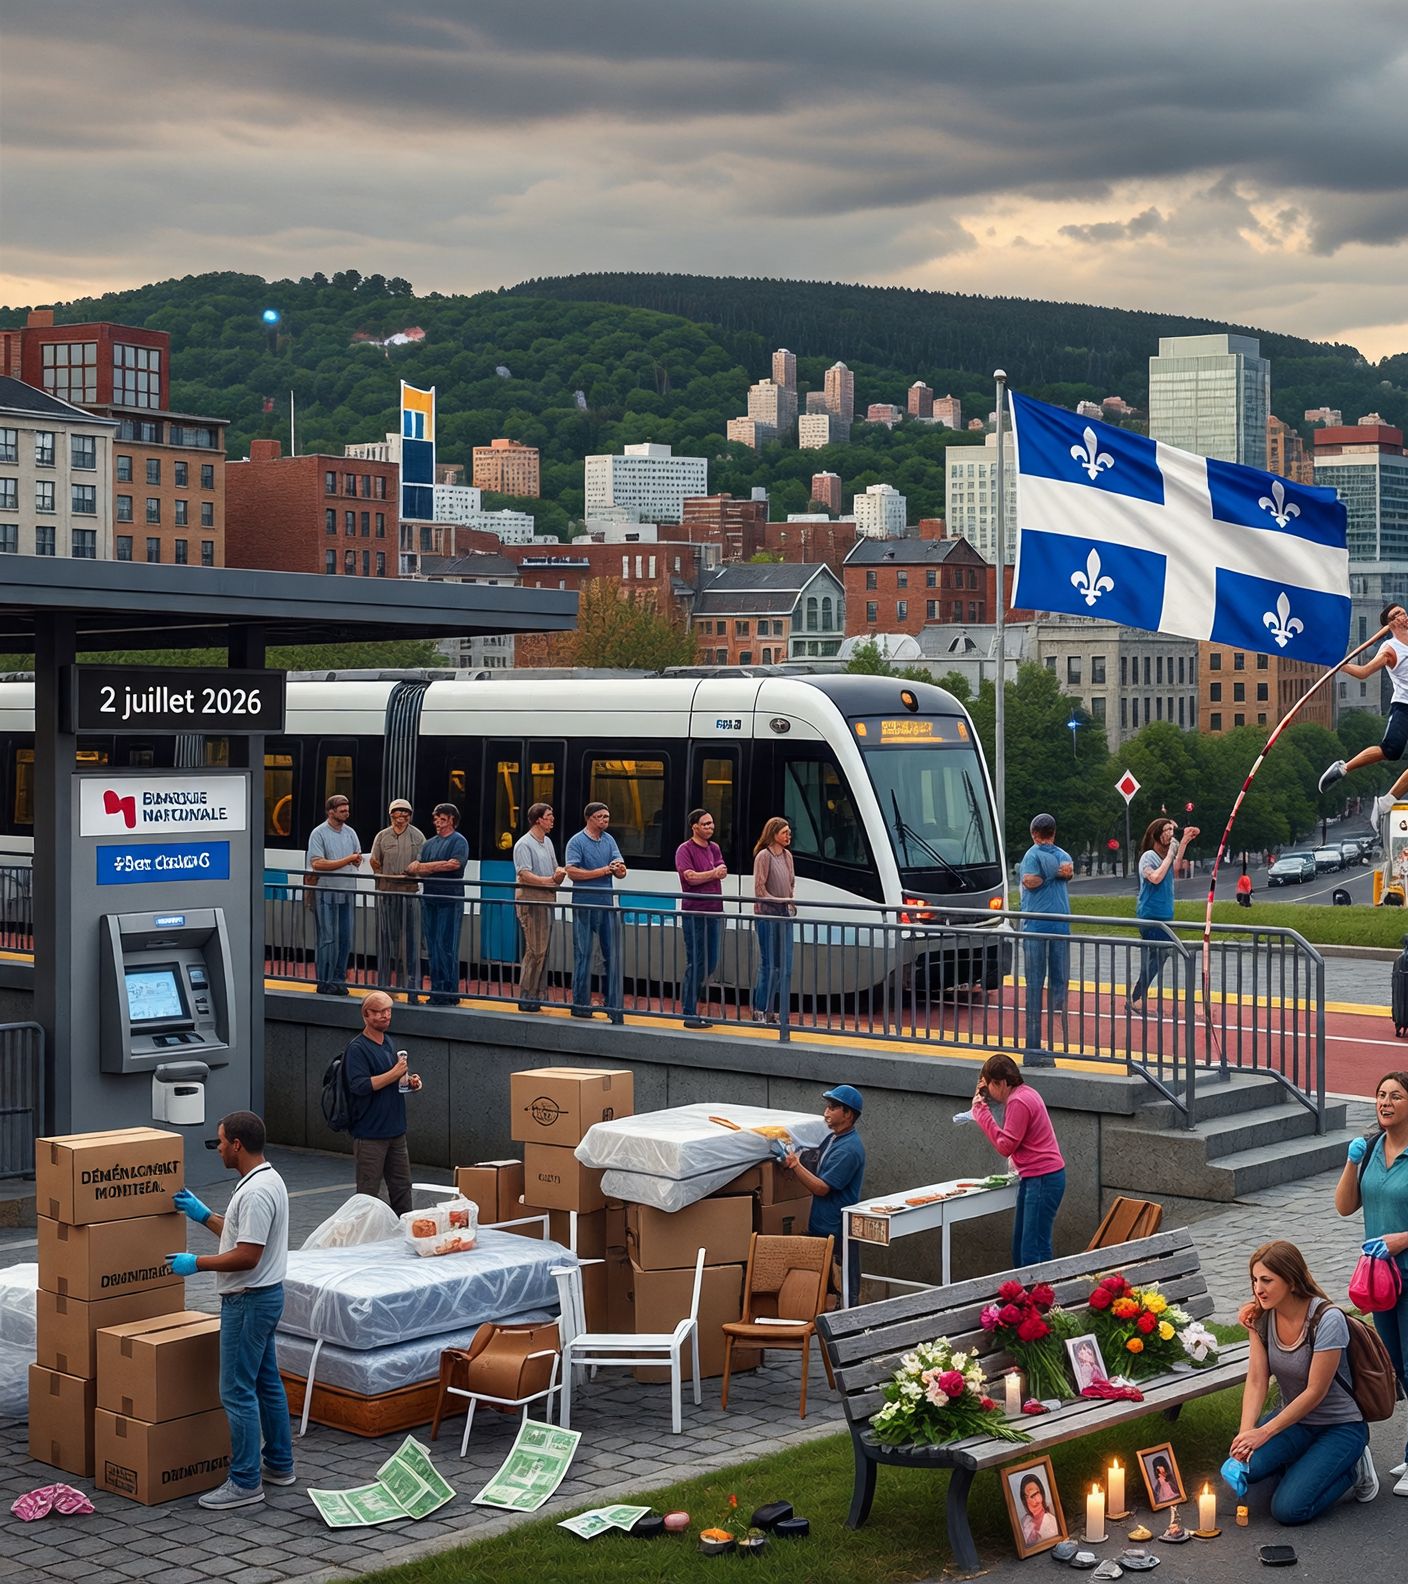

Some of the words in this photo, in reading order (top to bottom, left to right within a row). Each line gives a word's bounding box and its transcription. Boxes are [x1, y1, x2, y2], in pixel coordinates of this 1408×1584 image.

[100, 686, 116, 713] 2
[121, 686, 195, 720] juillet
[201, 688, 262, 715] 2026
